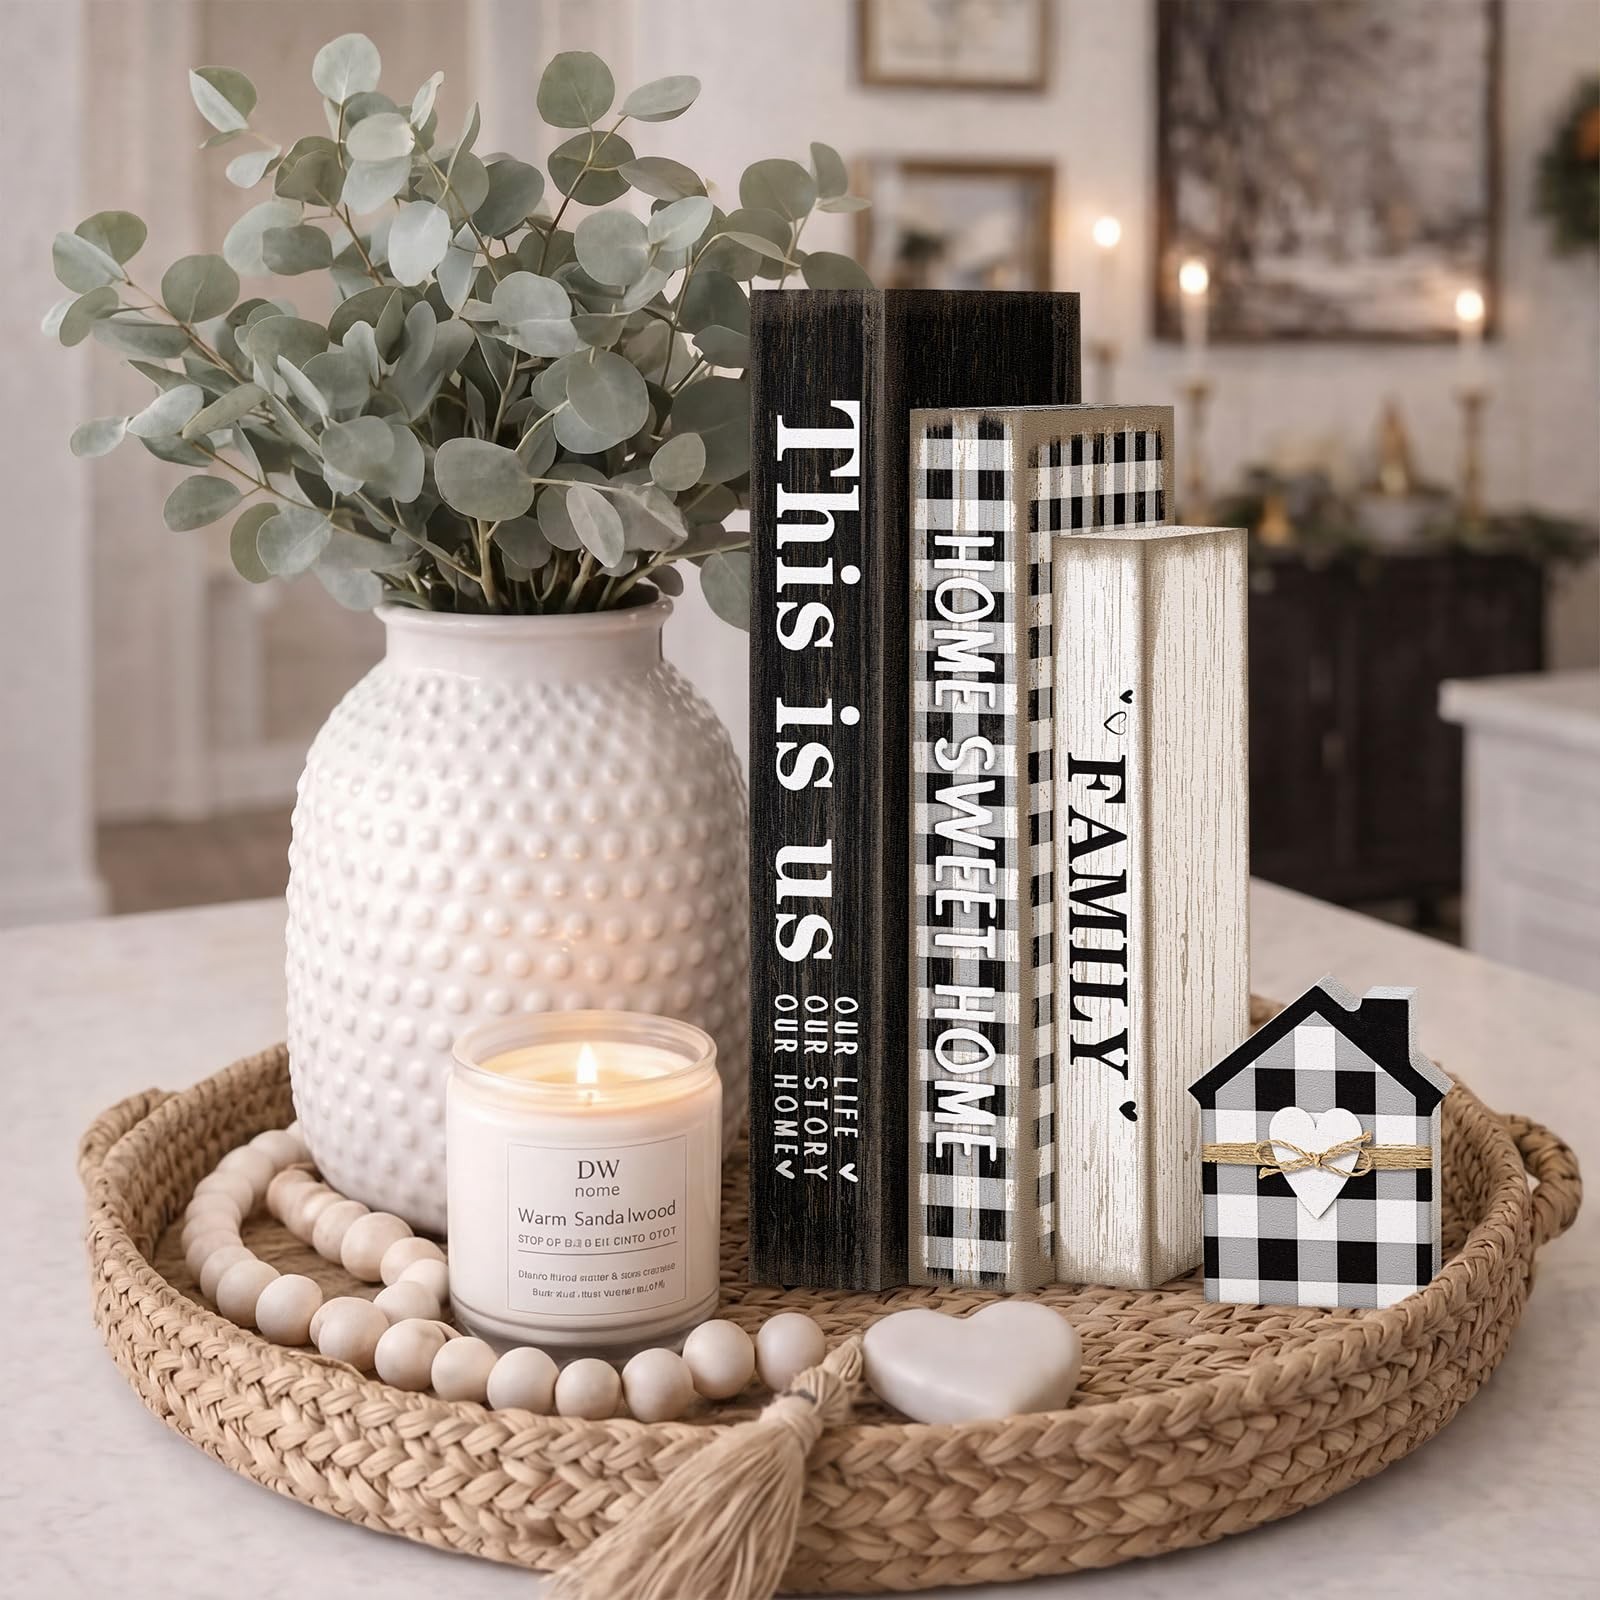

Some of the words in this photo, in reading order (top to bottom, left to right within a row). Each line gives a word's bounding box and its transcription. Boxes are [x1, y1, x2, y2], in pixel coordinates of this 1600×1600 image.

[776, 399, 861, 651] This
[933, 535, 996, 709] HOME
[776, 697, 861, 791] is
[933, 735, 997, 959] SWEET
[775, 838, 834, 963] us
[1067, 752, 1129, 1081] FAMILY
[774, 994, 799, 1054] OUR
[804, 995, 829, 1055] OUR
[834, 996, 859, 1056] OUR
[833, 1077, 859, 1138] LIFE
[933, 983, 997, 1162] HOME
[773, 1074, 799, 1155] HOME
[803, 1076, 829, 1181] STORY
[575, 1185, 621, 1198] nome
[577, 1159, 621, 1180] DW
[518, 1207, 567, 1227] Warm
[518, 1234, 544, 1246] STOP
